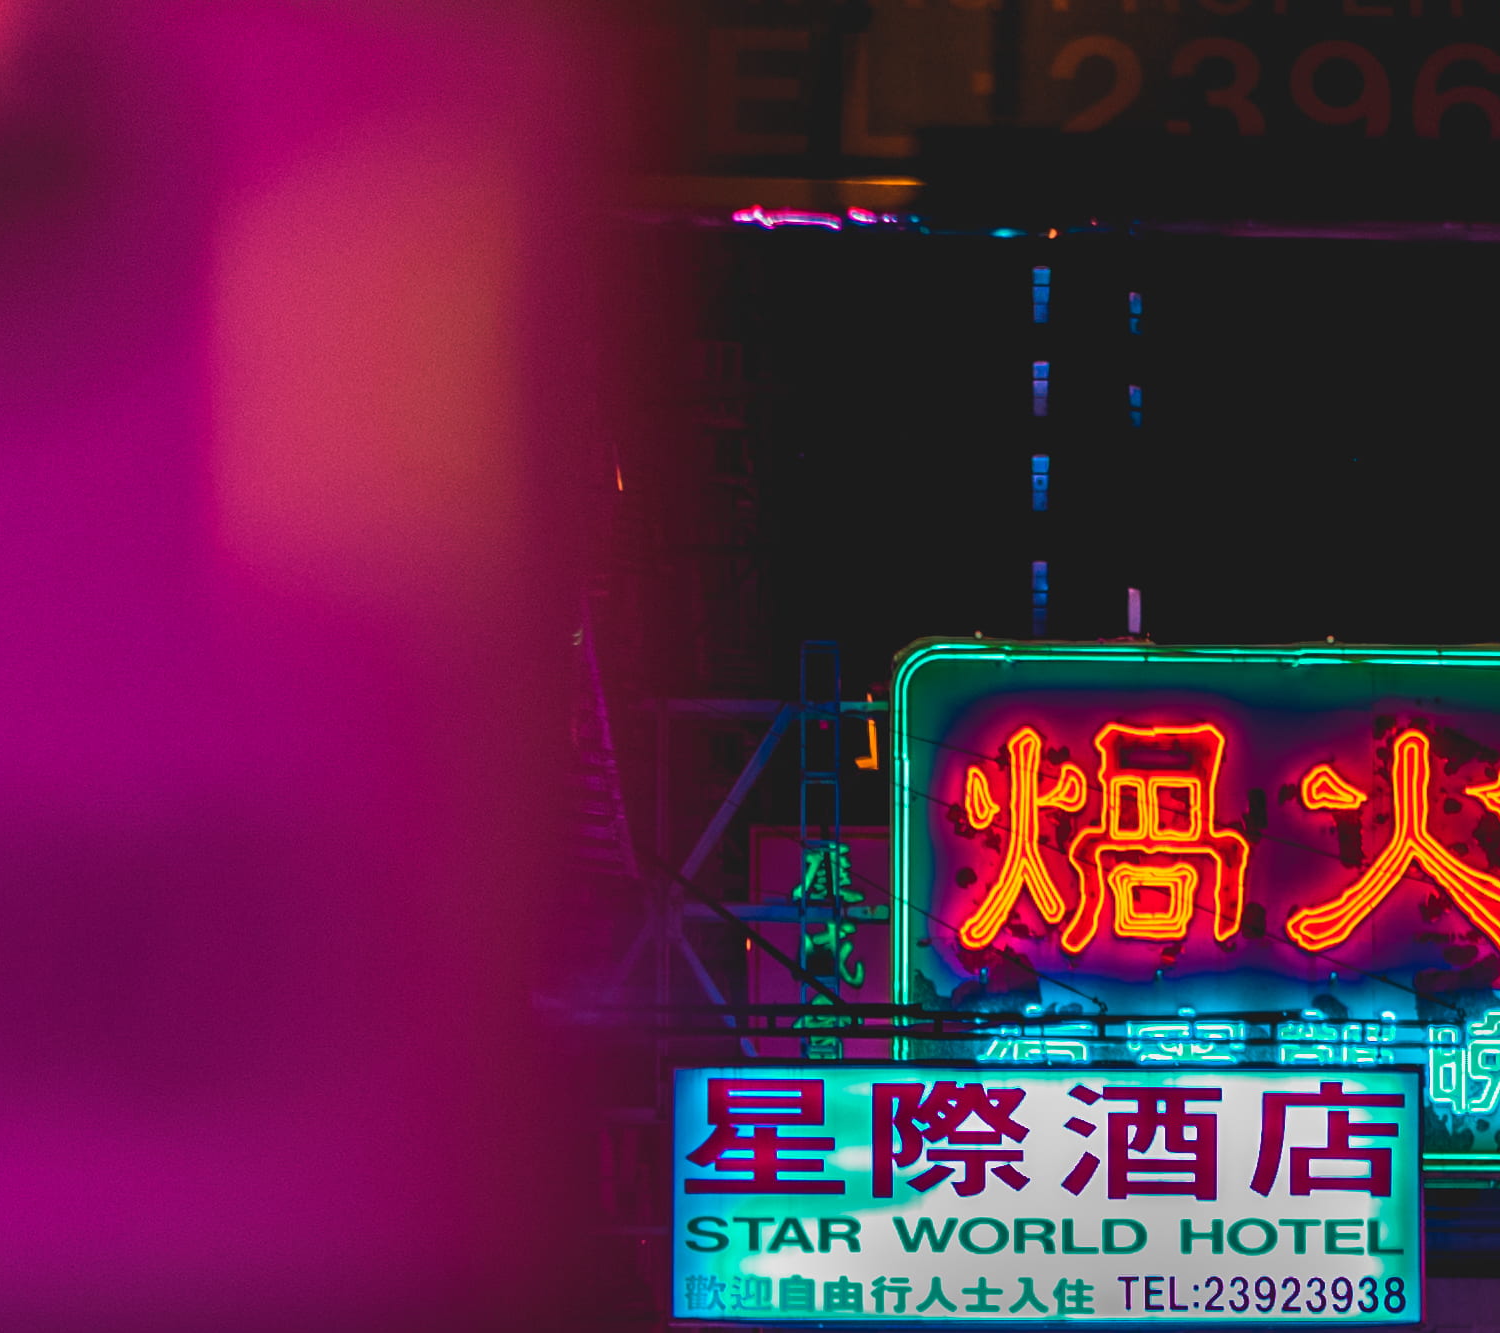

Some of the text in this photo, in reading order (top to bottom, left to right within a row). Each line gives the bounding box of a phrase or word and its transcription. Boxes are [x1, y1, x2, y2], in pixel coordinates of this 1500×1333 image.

[684, 1078, 1406, 1200] 星際酒店
[685, 1216, 1405, 1256] STAR WORLD HOTEL
[684, 1275, 1096, 1315] 歡迎自由行人士入住
[1118, 1275, 1407, 1314] TEL:23923938
